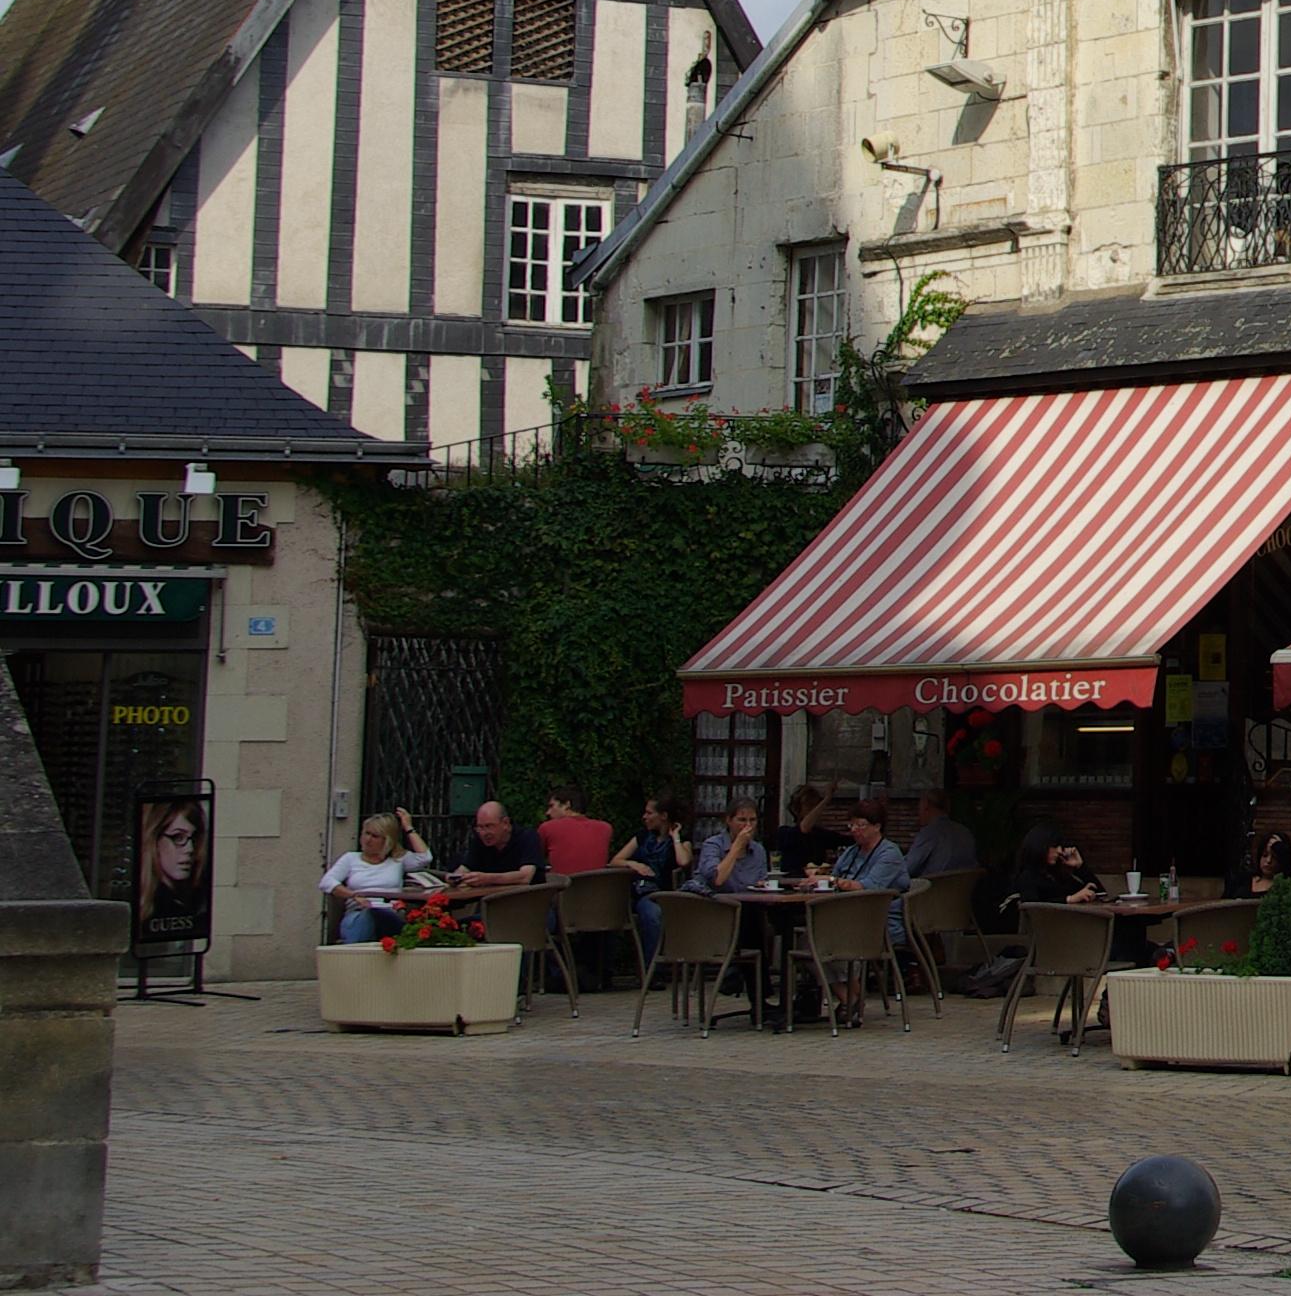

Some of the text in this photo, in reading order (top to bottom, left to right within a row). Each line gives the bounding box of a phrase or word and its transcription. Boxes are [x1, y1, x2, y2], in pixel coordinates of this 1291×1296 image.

[0, 490, 272, 560] IQUE
[0, 580, 167, 616] LLOUX
[256, 621, 267, 632] 4
[723, 673, 1107, 708] Patissier Chocolatier
[112, 706, 191, 725] PHOTO
[149, 915, 194, 932] GUESS
